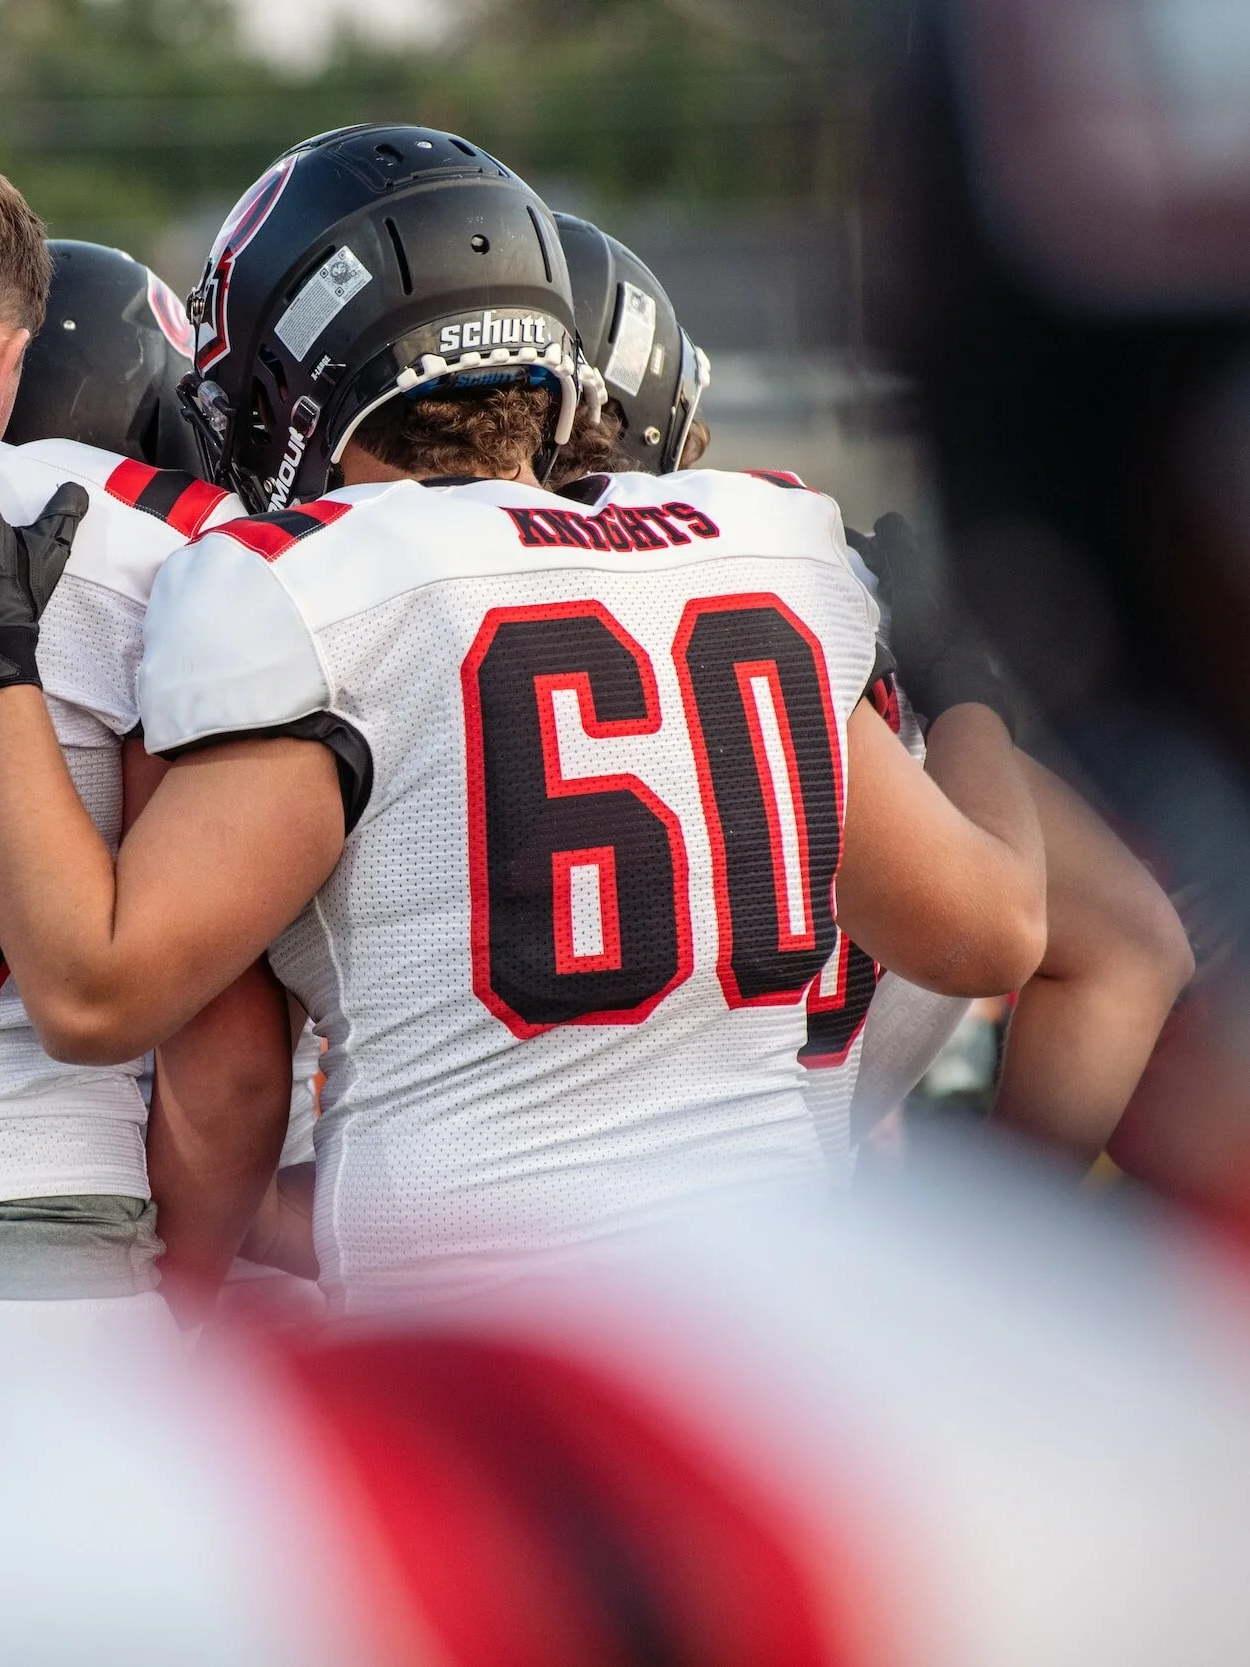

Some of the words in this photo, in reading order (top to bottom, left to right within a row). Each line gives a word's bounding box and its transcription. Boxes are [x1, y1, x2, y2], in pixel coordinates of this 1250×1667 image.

[440, 311, 546, 353] schutt
[497, 502, 720, 552] KNIGHTS
[461, 592, 848, 1041] 60
